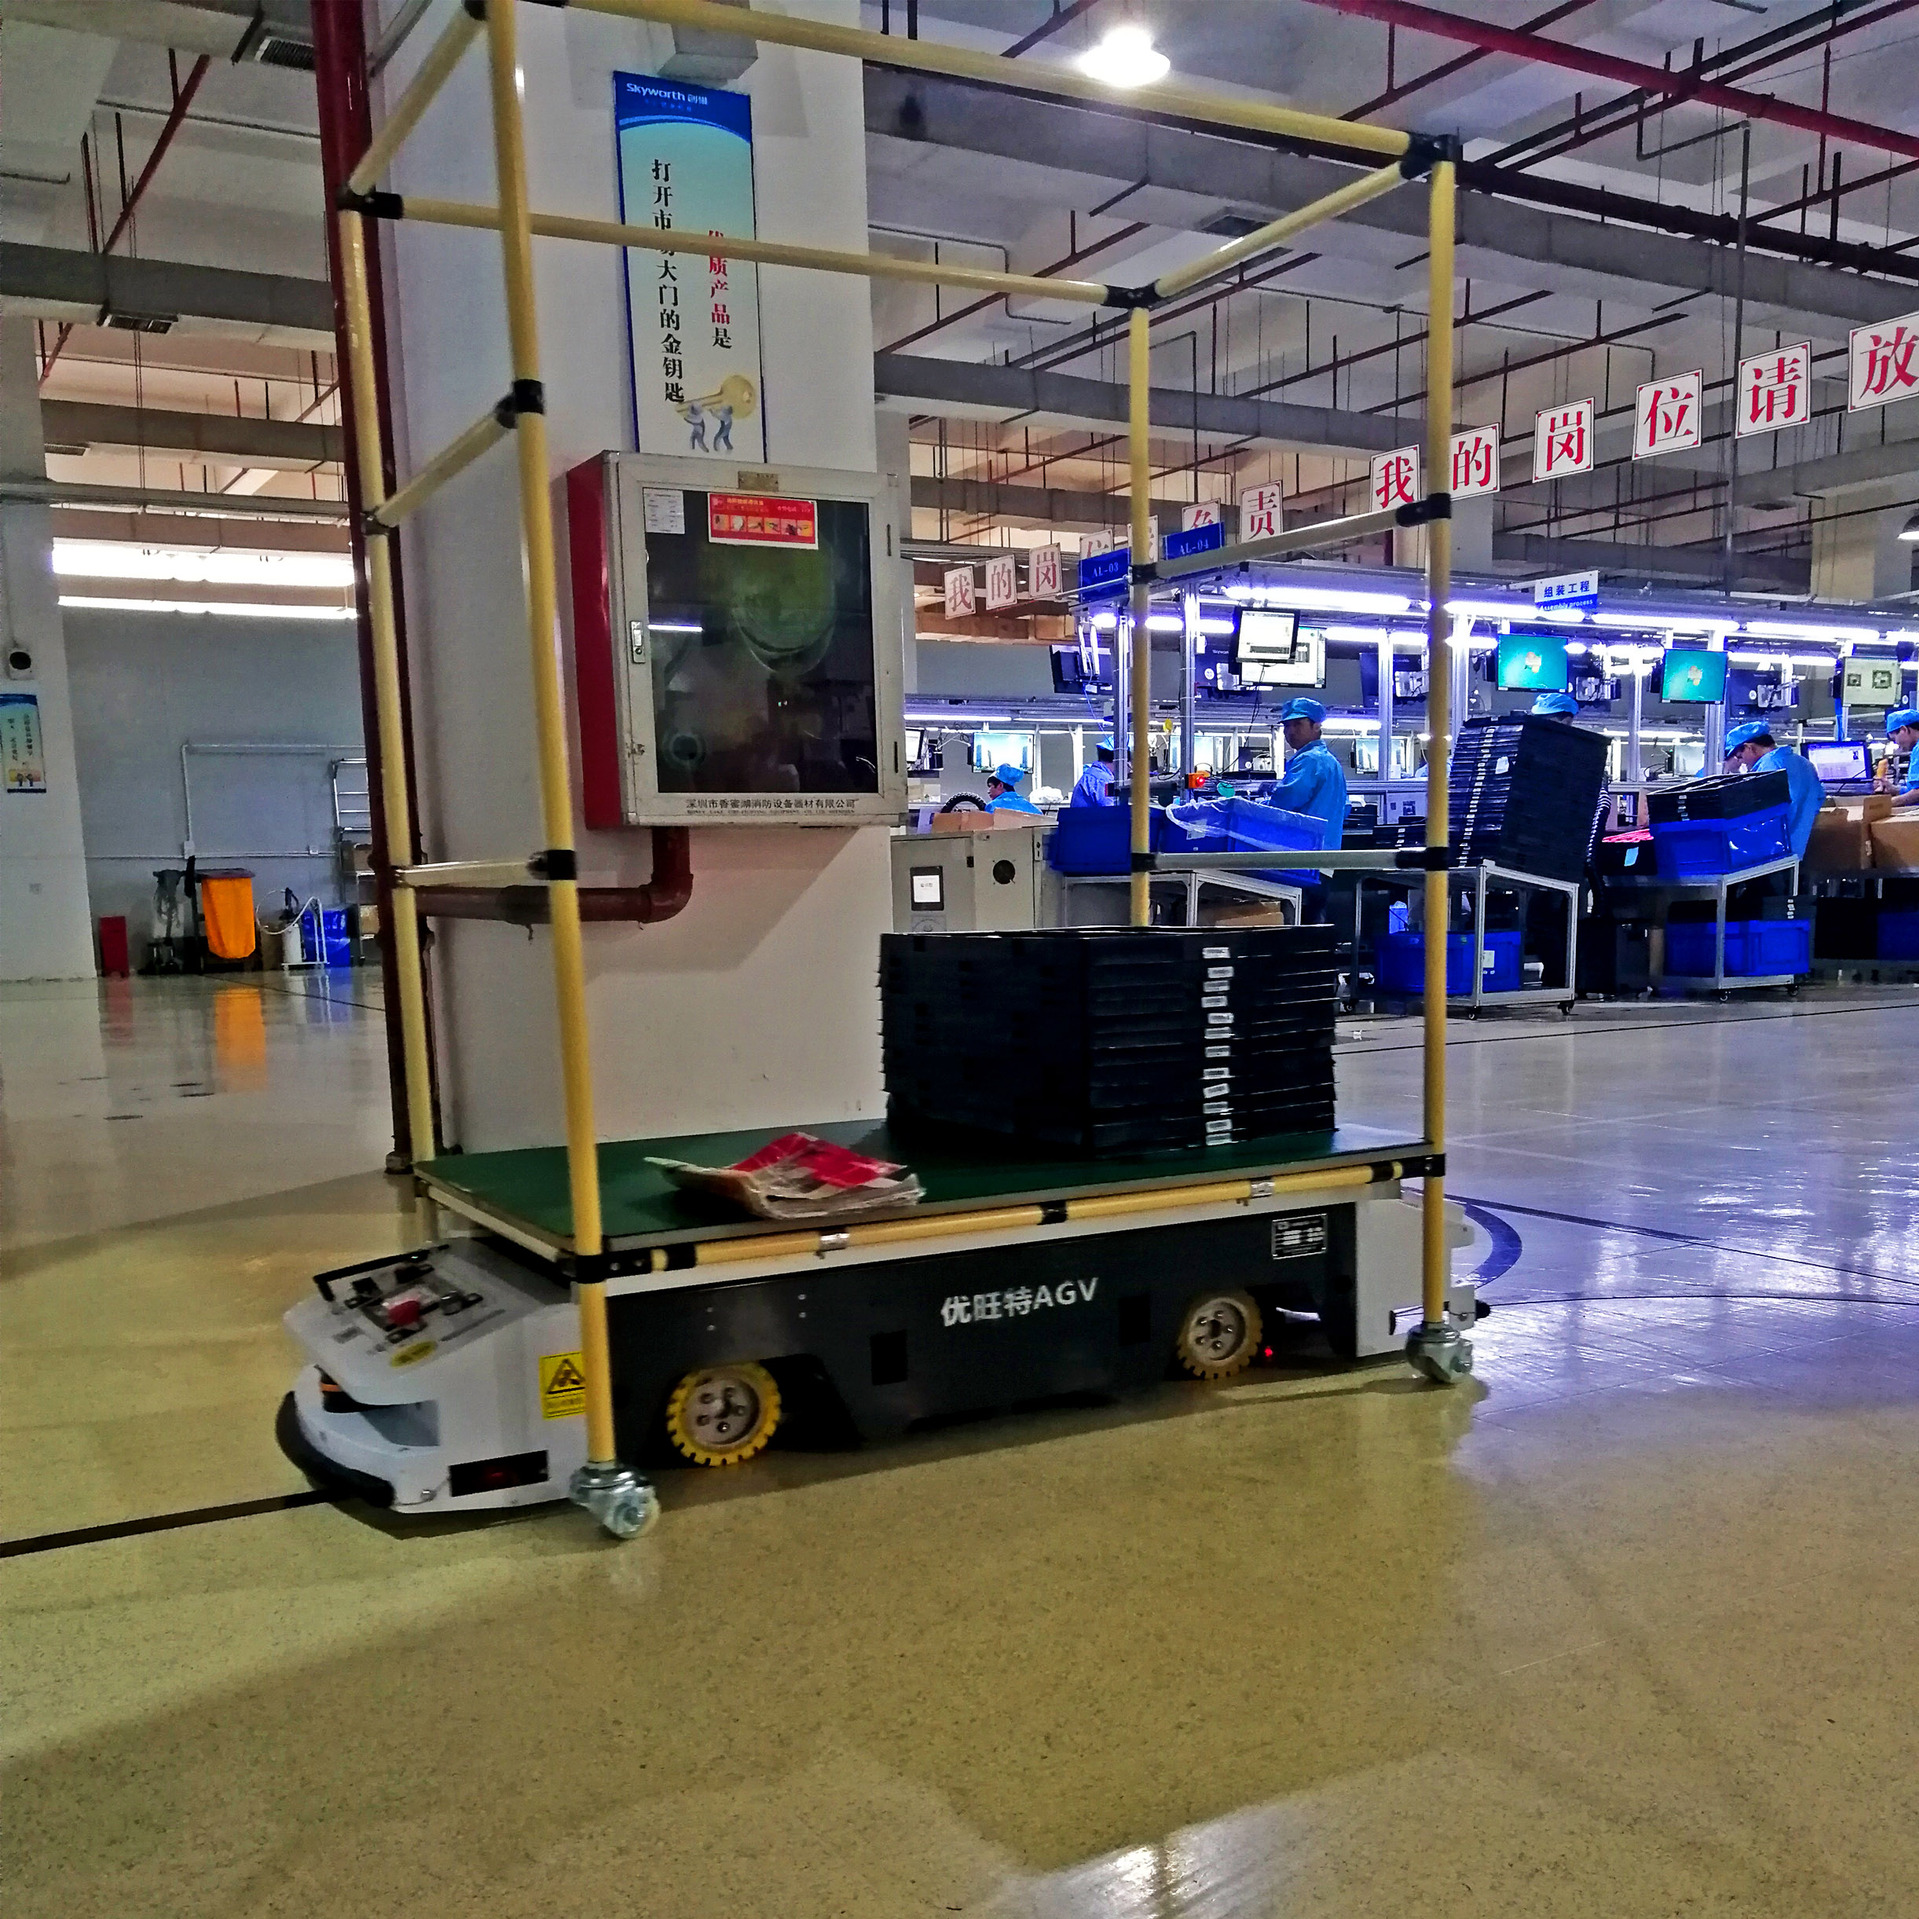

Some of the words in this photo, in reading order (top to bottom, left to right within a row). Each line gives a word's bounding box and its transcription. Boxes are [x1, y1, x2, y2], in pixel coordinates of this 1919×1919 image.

[626, 82, 685, 101] Skyworth
[652, 159, 685, 403] 打开市大门的金钥匙
[708, 230, 733, 349] 质产品是
[1247, 491, 1278, 540] 责
[1179, 538, 1209, 555] AL-04
[1091, 561, 1119, 578] AL-03
[1543, 580, 1590, 598] 组装工程
[940, 1277, 1099, 1327] 优旺特AGV
